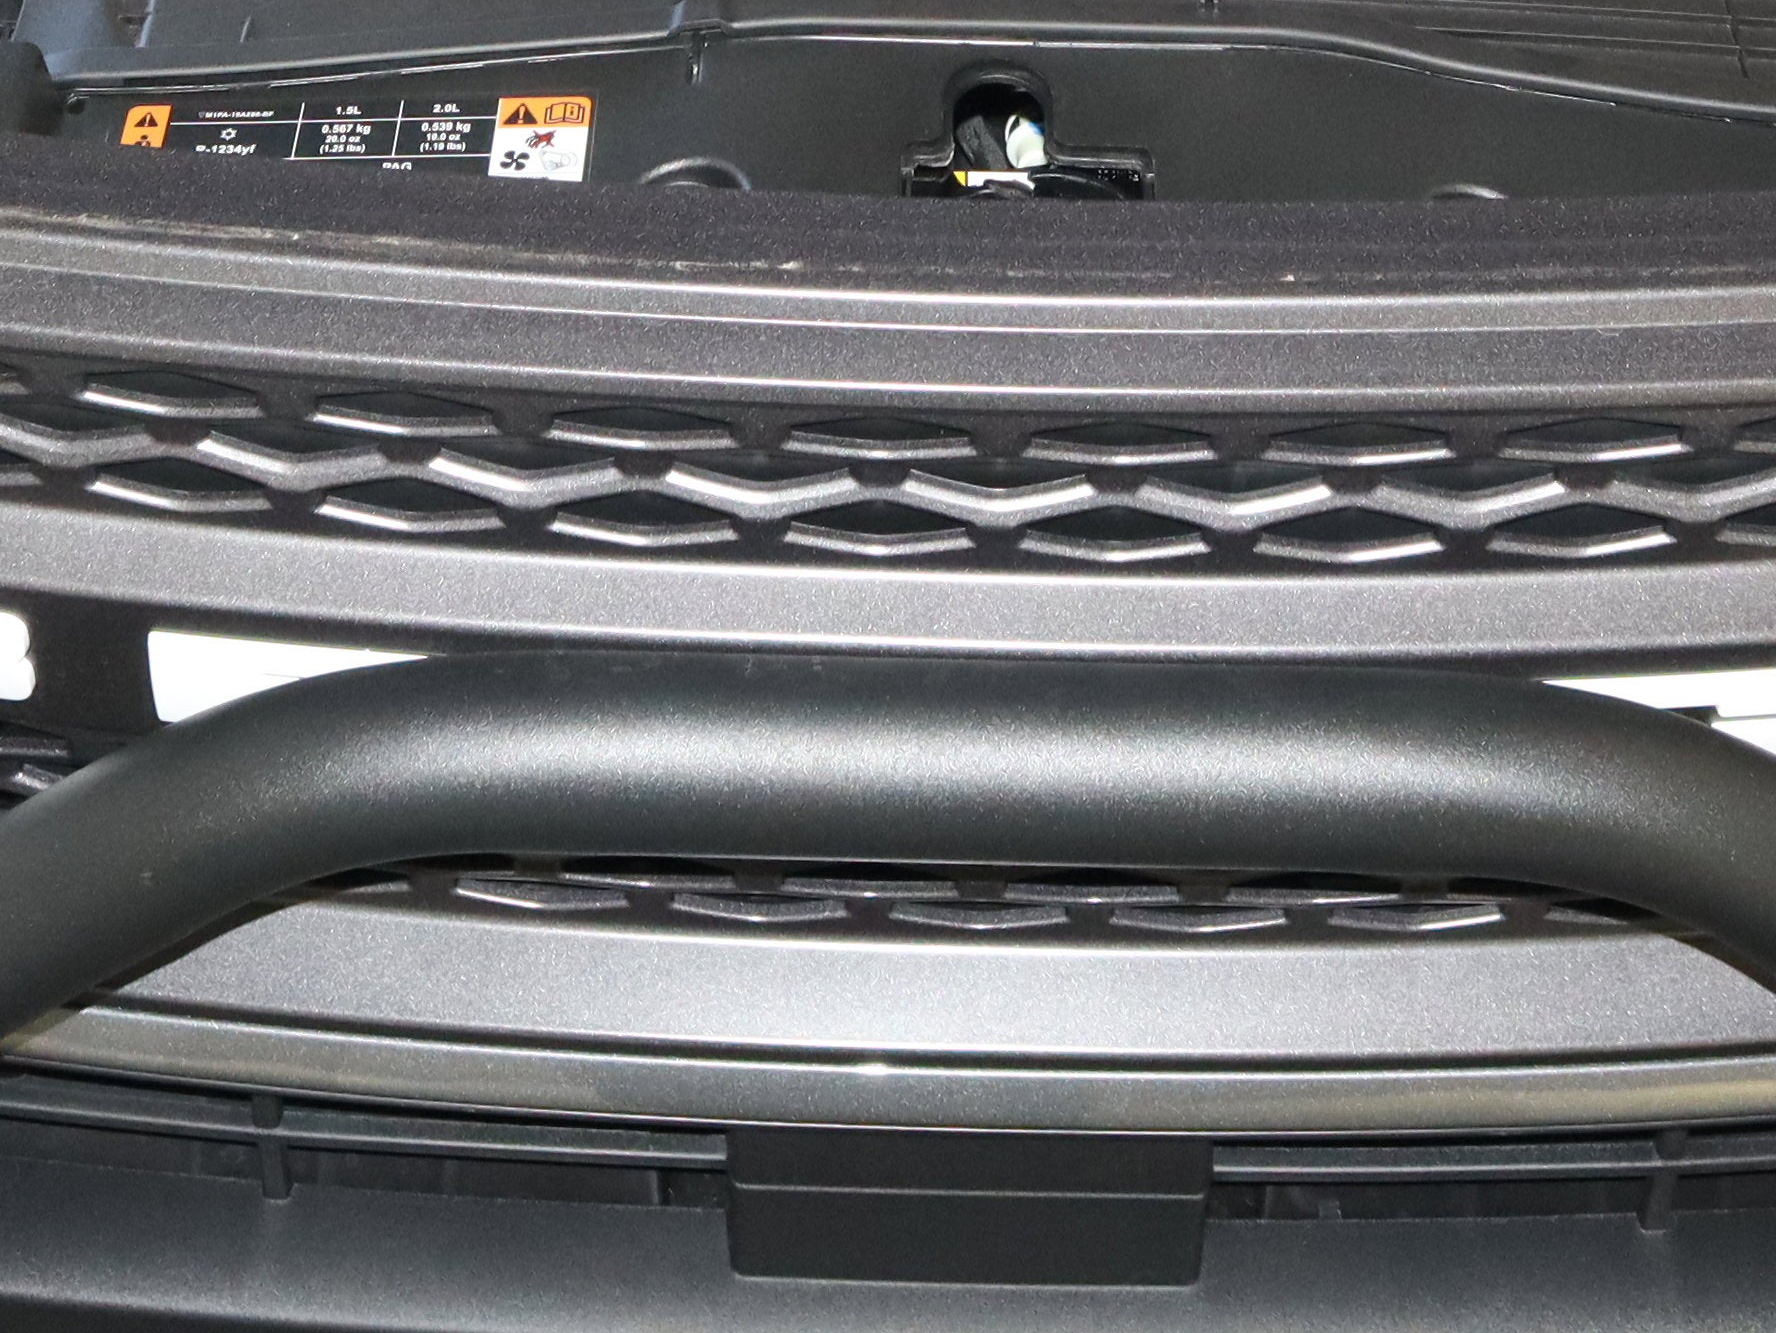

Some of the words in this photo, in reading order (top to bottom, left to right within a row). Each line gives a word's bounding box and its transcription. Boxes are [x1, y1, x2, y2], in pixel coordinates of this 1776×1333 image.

[336, 105, 362, 115] 1.5L
[432, 103, 460, 113] 2.0L
[355, 123, 371, 135] kg
[421, 122, 454, 132] 0.539
[455, 121, 471, 133] kg
[448, 133, 461, 141] oz
